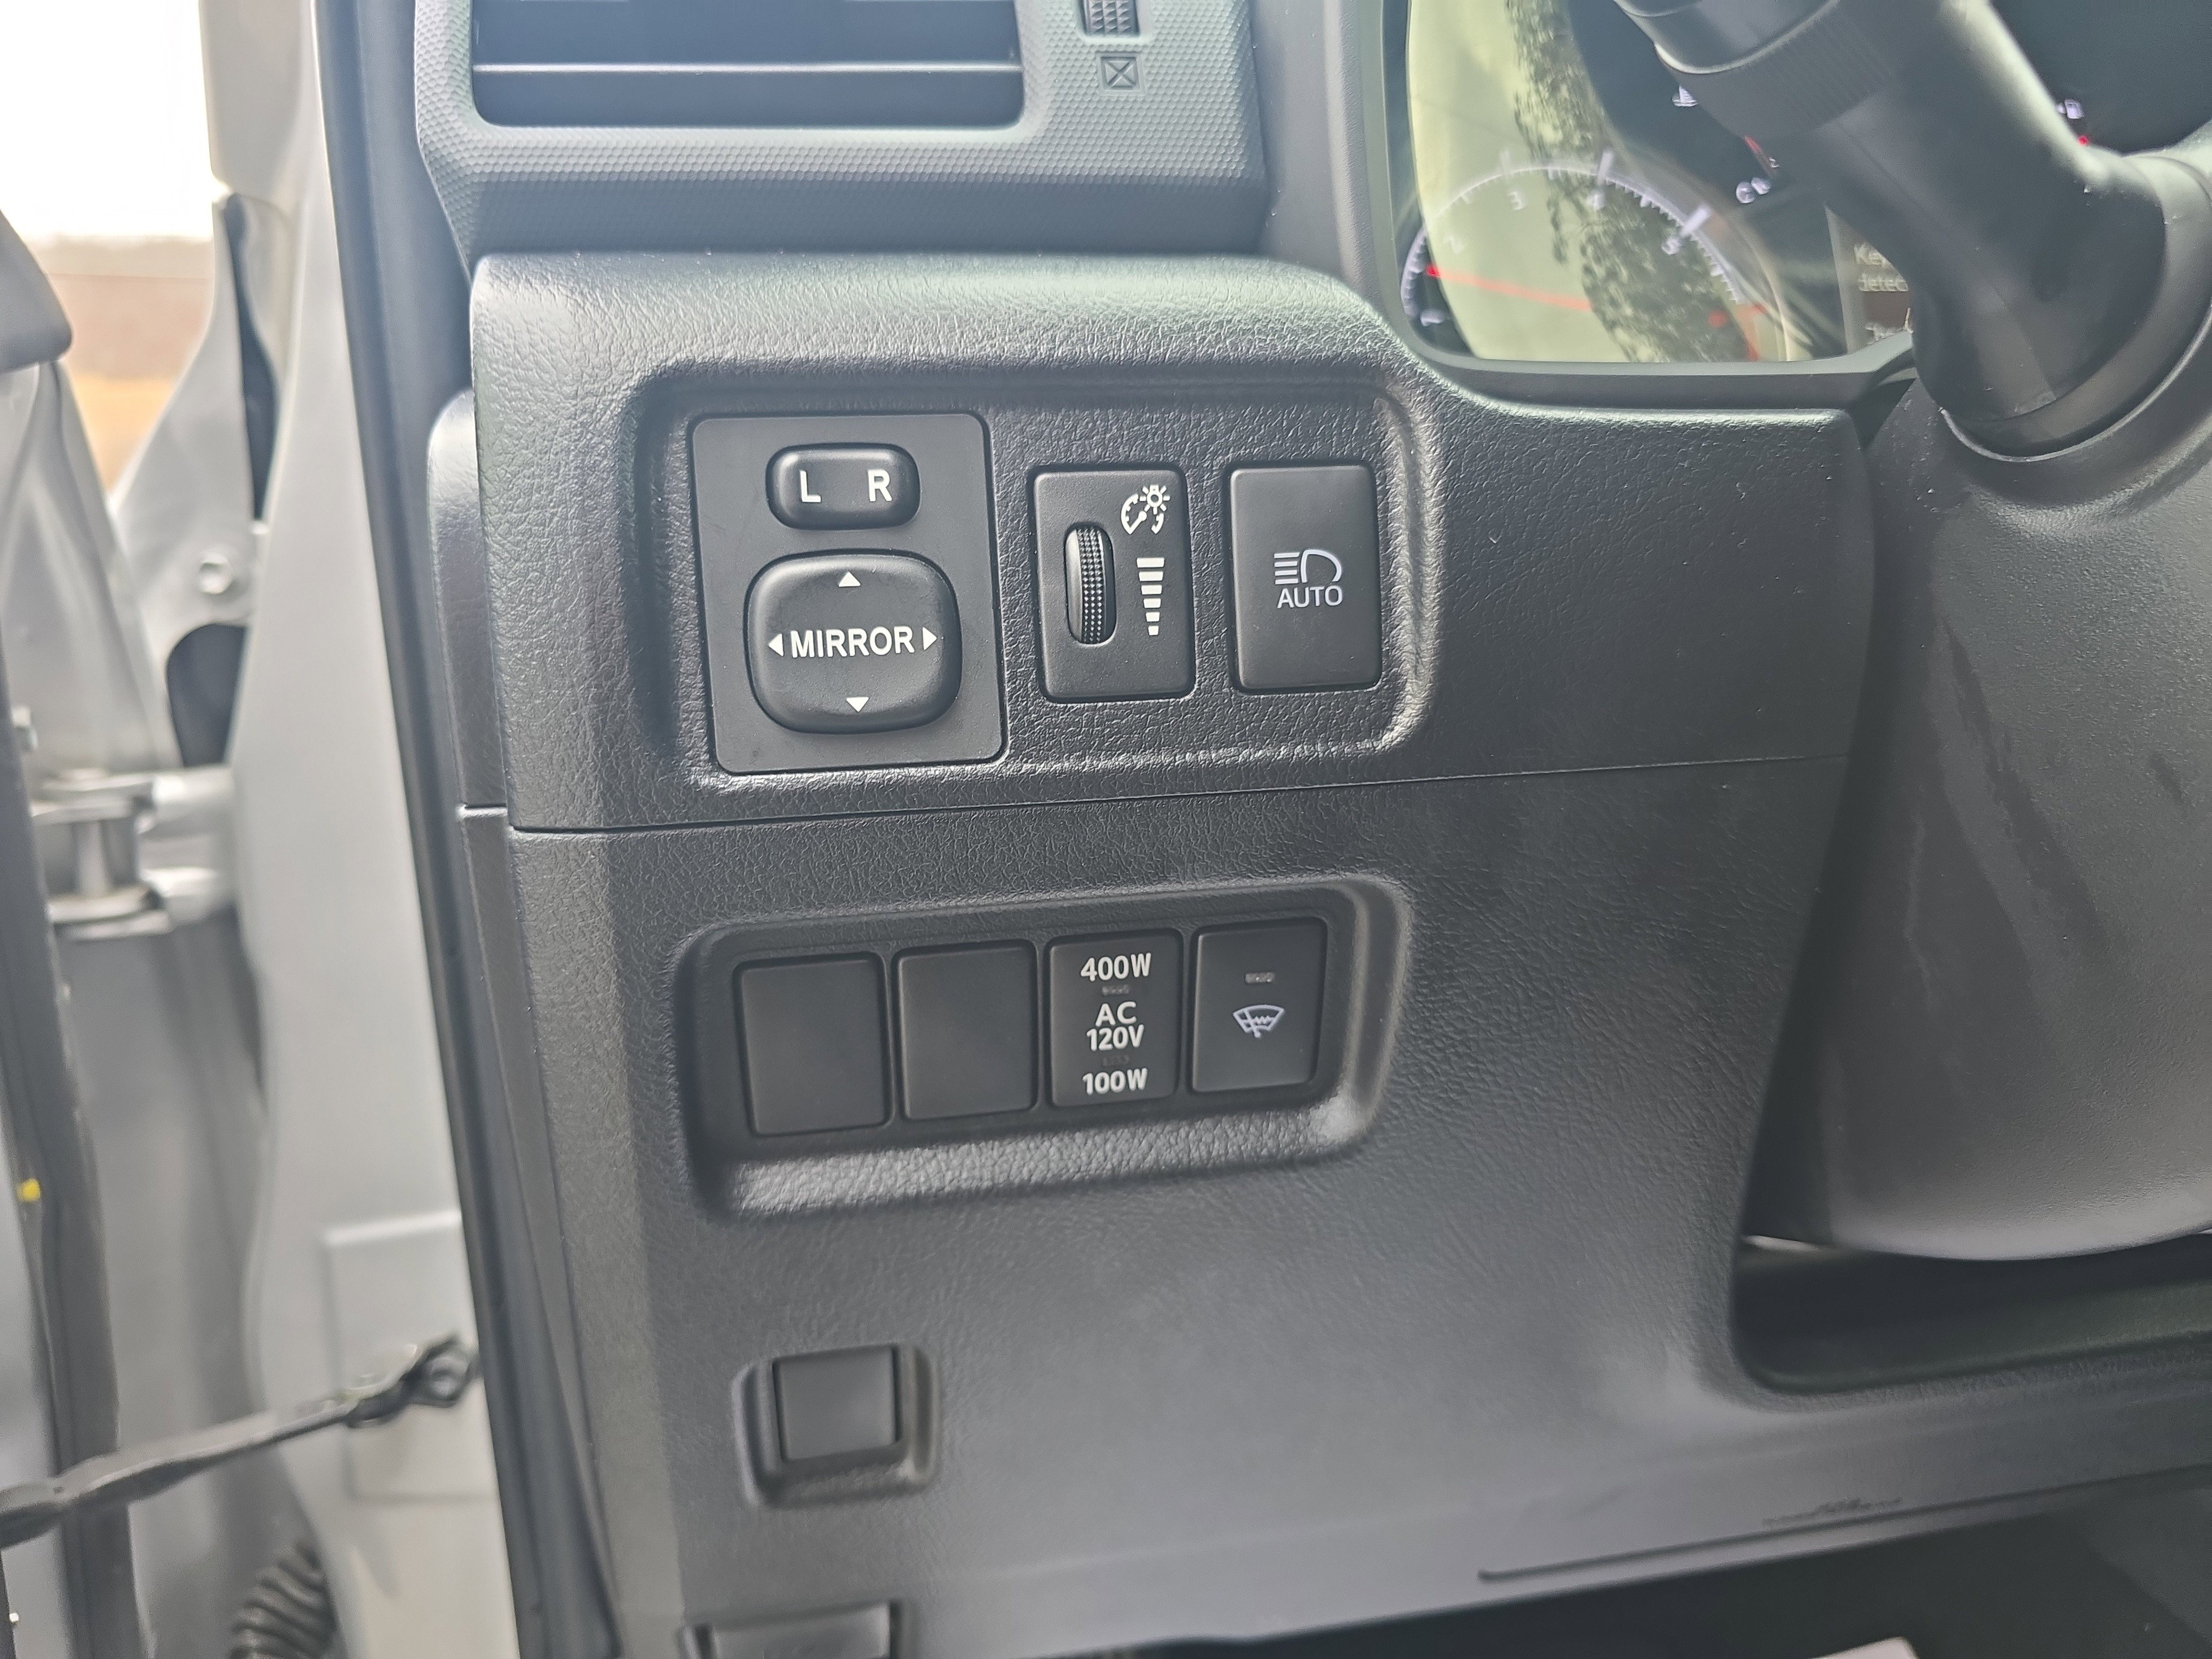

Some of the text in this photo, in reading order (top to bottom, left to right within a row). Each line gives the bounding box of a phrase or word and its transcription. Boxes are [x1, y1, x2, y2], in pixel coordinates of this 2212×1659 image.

[799, 468, 893, 504] L R
[1276, 584, 1344, 609] AUTO
[790, 626, 915, 659] MIRROR
[1080, 952, 1152, 982] 400W
[1095, 1001, 1137, 1027] AC
[1085, 1024, 1144, 1051] 120V
[1082, 1068, 1148, 1096] 100W
